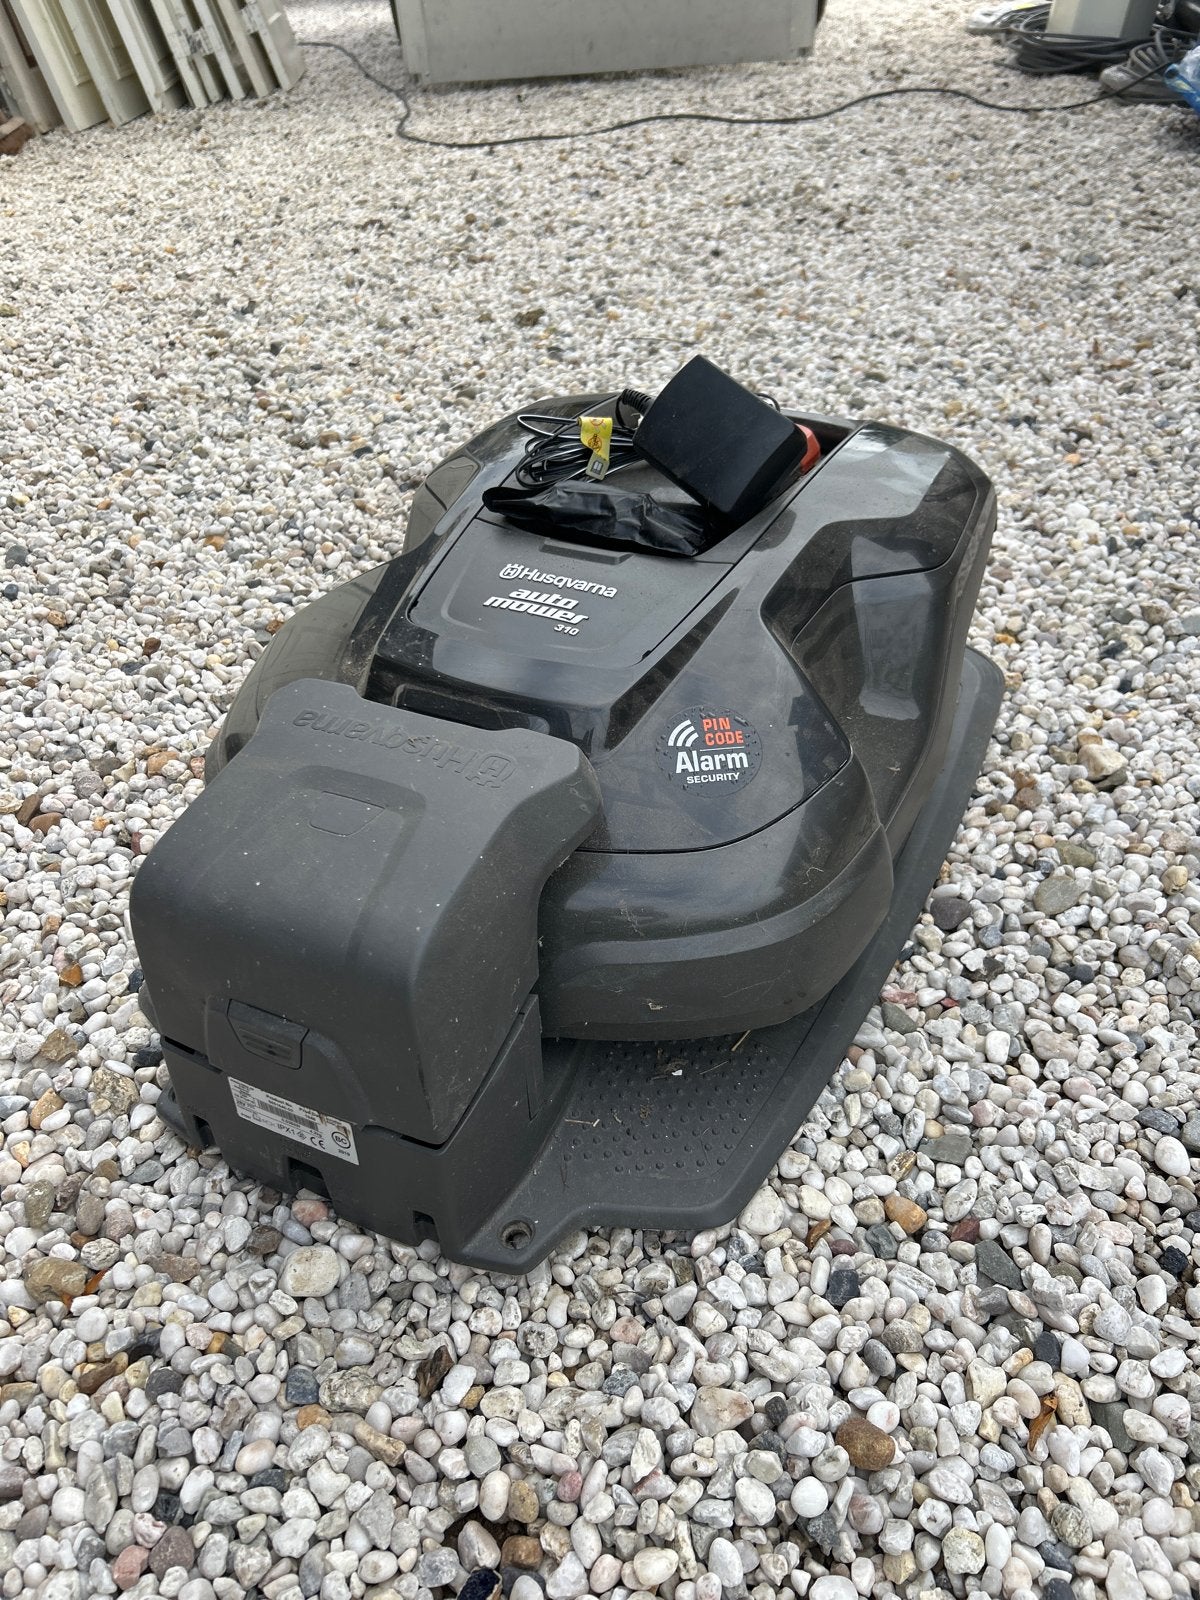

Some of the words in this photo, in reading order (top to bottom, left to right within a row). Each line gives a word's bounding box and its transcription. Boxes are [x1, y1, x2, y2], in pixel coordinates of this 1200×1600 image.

[519, 567, 617, 598] Husqvarna
[509, 588, 579, 609] auto
[483, 596, 589, 624] mower
[554, 624, 580, 636] 310
[702, 717, 731, 731] PIN
[292, 708, 478, 774] Husqvarna
[705, 730, 744, 746] CODE
[675, 750, 749, 774] Alarm
[686, 772, 740, 784] SECURITY
